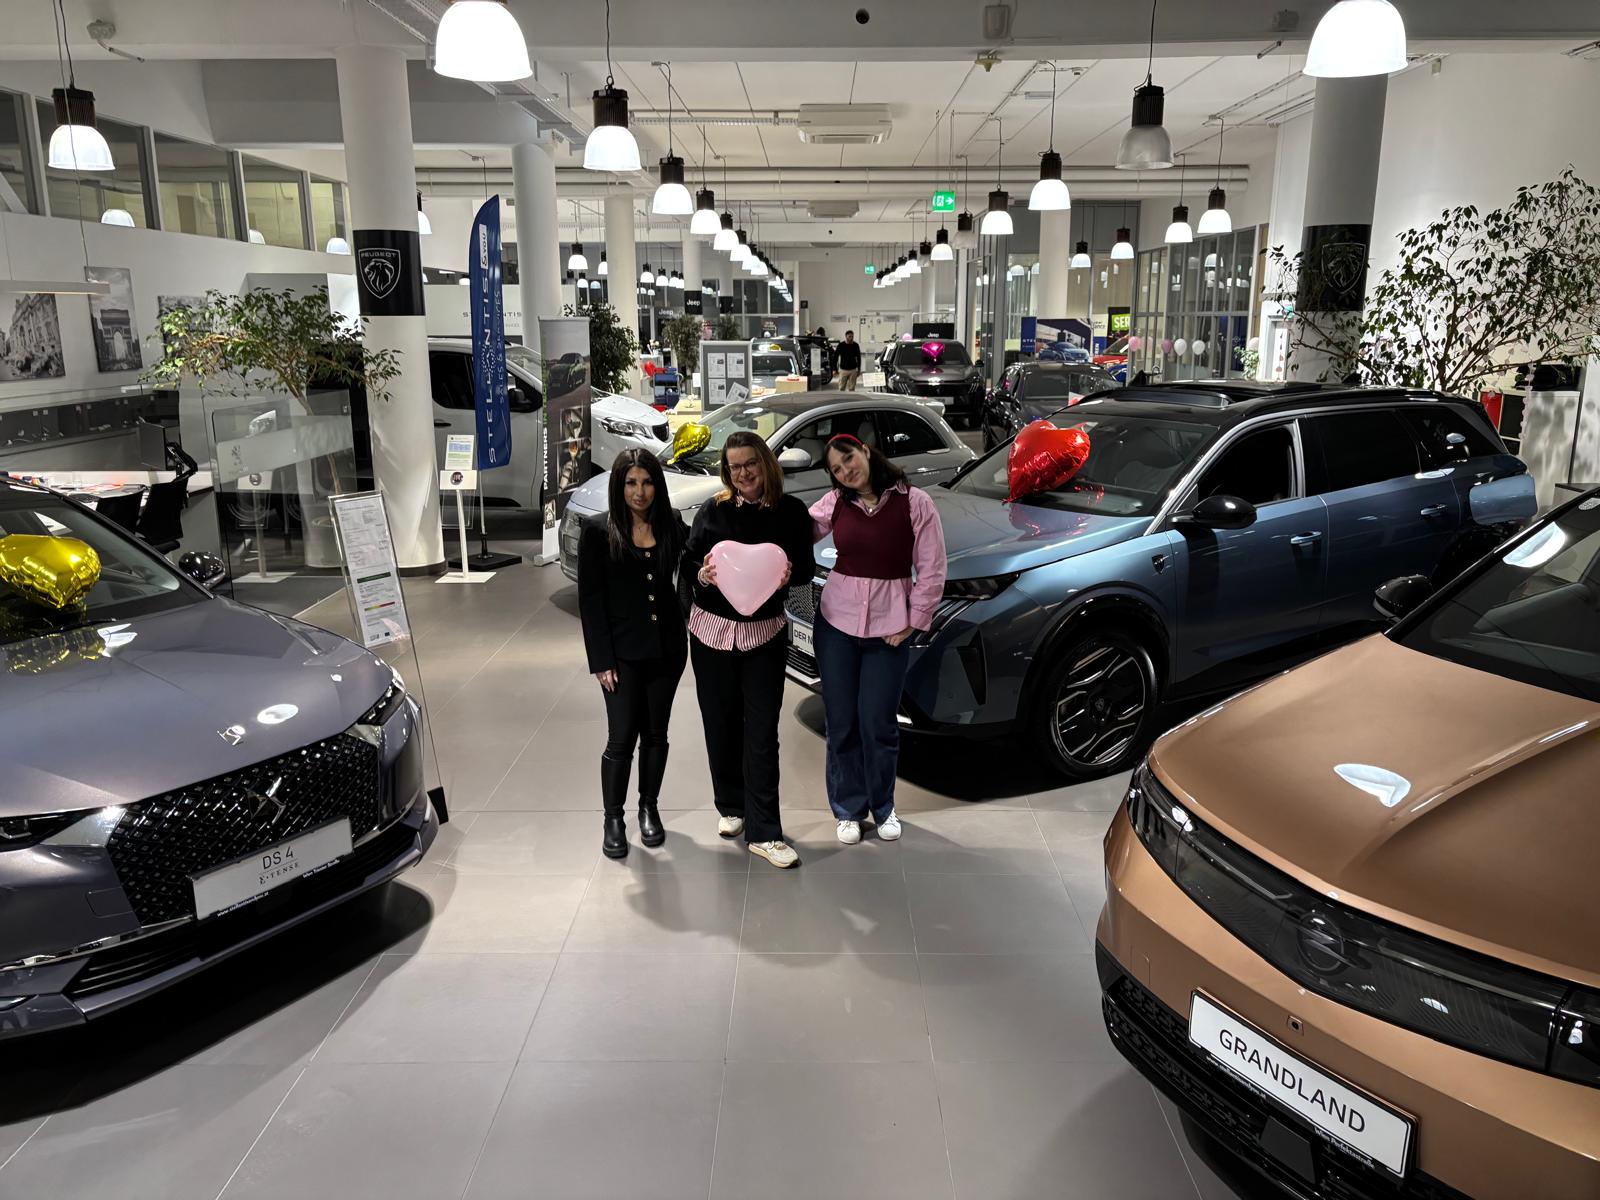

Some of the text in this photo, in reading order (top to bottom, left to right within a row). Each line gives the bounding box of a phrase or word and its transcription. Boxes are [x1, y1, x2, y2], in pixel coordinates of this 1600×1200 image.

[794, 629, 807, 643] DER
[262, 845, 294, 870] DS 4
[1219, 1029, 1366, 1133] GRANDLAND
